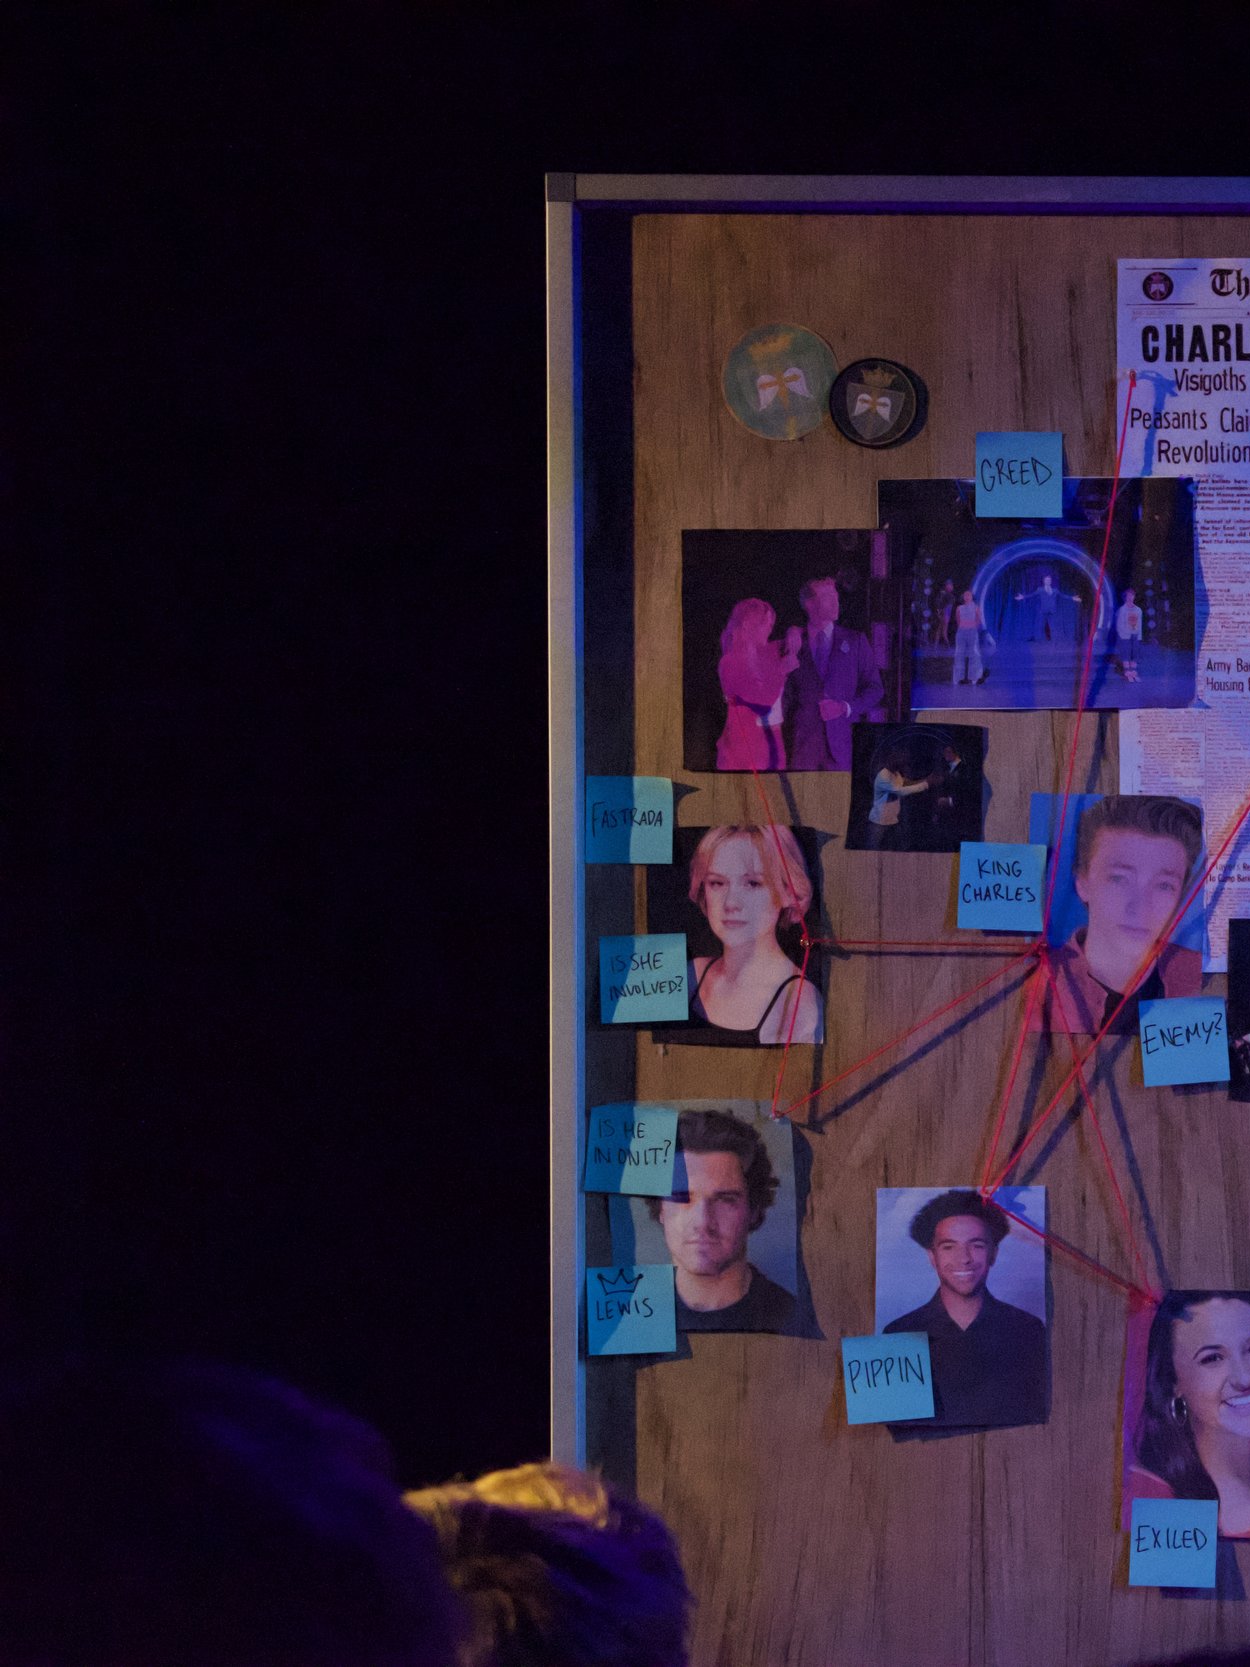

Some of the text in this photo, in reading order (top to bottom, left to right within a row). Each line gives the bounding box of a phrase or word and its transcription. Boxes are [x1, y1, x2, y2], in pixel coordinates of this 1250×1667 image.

[1174, 368, 1247, 396] Visigoths
[1130, 407, 1207, 430] Peasants
[981, 457, 1052, 492] GREED
[1206, 658, 1231, 674] Army
[1206, 677, 1244, 693] Housing
[592, 801, 663, 838] FASTRADA
[978, 858, 1022, 879] KING
[962, 883, 1036, 904] CHARLES
[610, 952, 663, 973] IS SHE
[609, 975, 684, 1001] INVOLVED?
[1142, 1013, 1223, 1055] ENEMY?
[599, 1119, 646, 1139] IS HE
[594, 1139, 672, 1166] IN ON IT?
[596, 1298, 654, 1321] LEWIS
[848, 1353, 925, 1394] PIPPIN
[1136, 1525, 1207, 1553] EXILED
